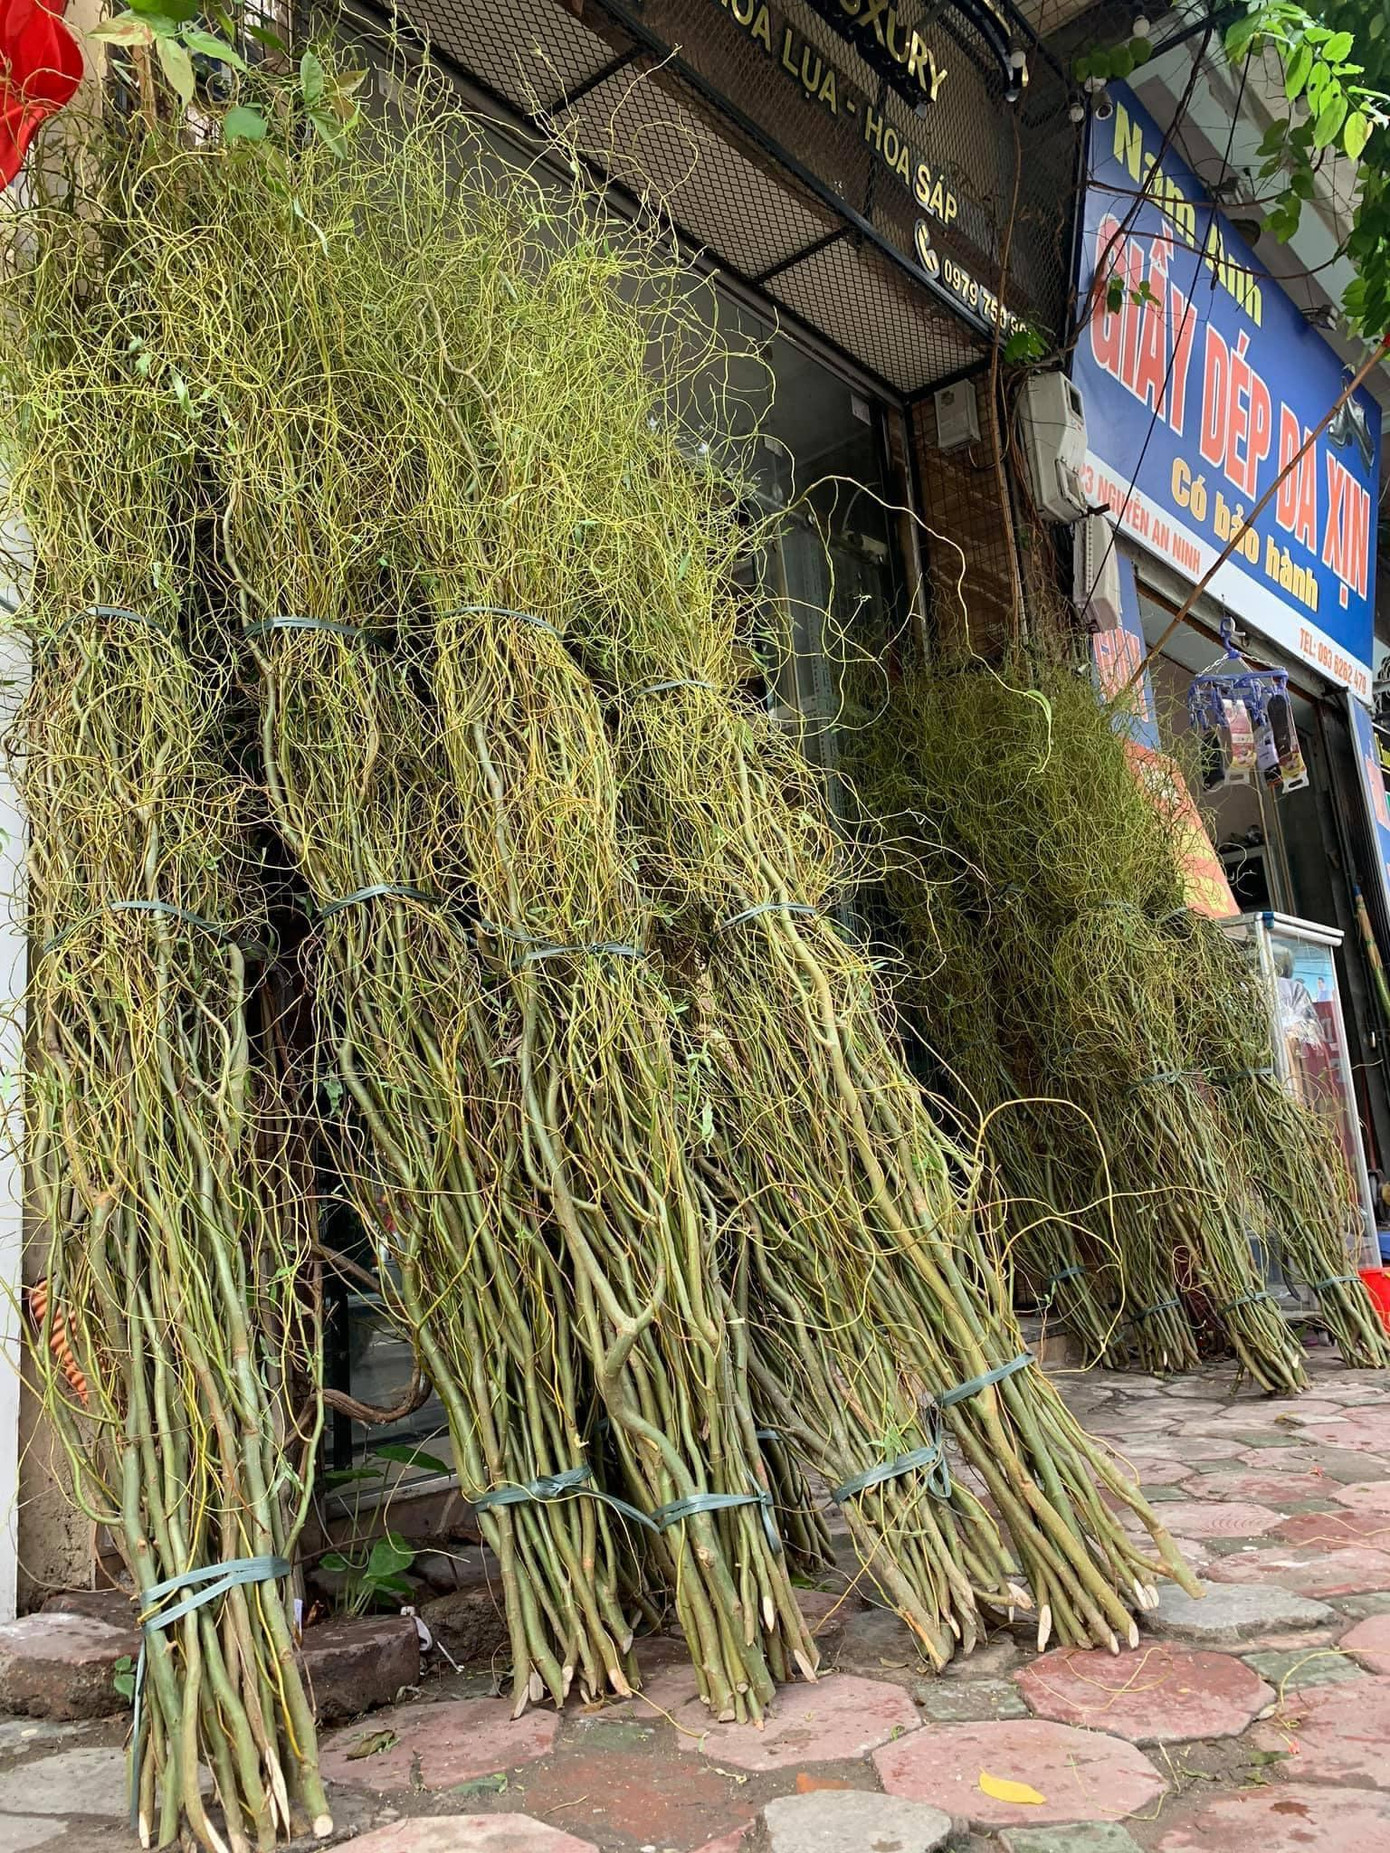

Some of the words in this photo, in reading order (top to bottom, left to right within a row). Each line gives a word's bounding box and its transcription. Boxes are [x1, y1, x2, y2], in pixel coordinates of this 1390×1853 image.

[721, 0, 771, 52] OA
[782, 28, 837, 115] LỤA
[864, 106, 910, 186] HOA
[915, 164, 957, 224] SÁP
[841, 0, 948, 102] XURY
[1113, 101, 1197, 248] Nam
[1204, 222, 1263, 328] Anh
[944, 258, 979, 306] 0979
[1089, 213, 1198, 438] GIẦY
[1199, 320, 1272, 500] DÉP
[1275, 400, 1318, 557] DA
[1321, 448, 1370, 611] XỊN
[1097, 473, 1150, 538] NGUYỄN
[1152, 517, 1170, 552] AN
[1172, 532, 1201, 575] NINH
[1171, 457, 1207, 522] Có
[1213, 490, 1260, 565] bảo
[1265, 534, 1318, 613] hành
[1300, 627, 1317, 656] TEL:
[1318, 641, 1333, 670] 093
